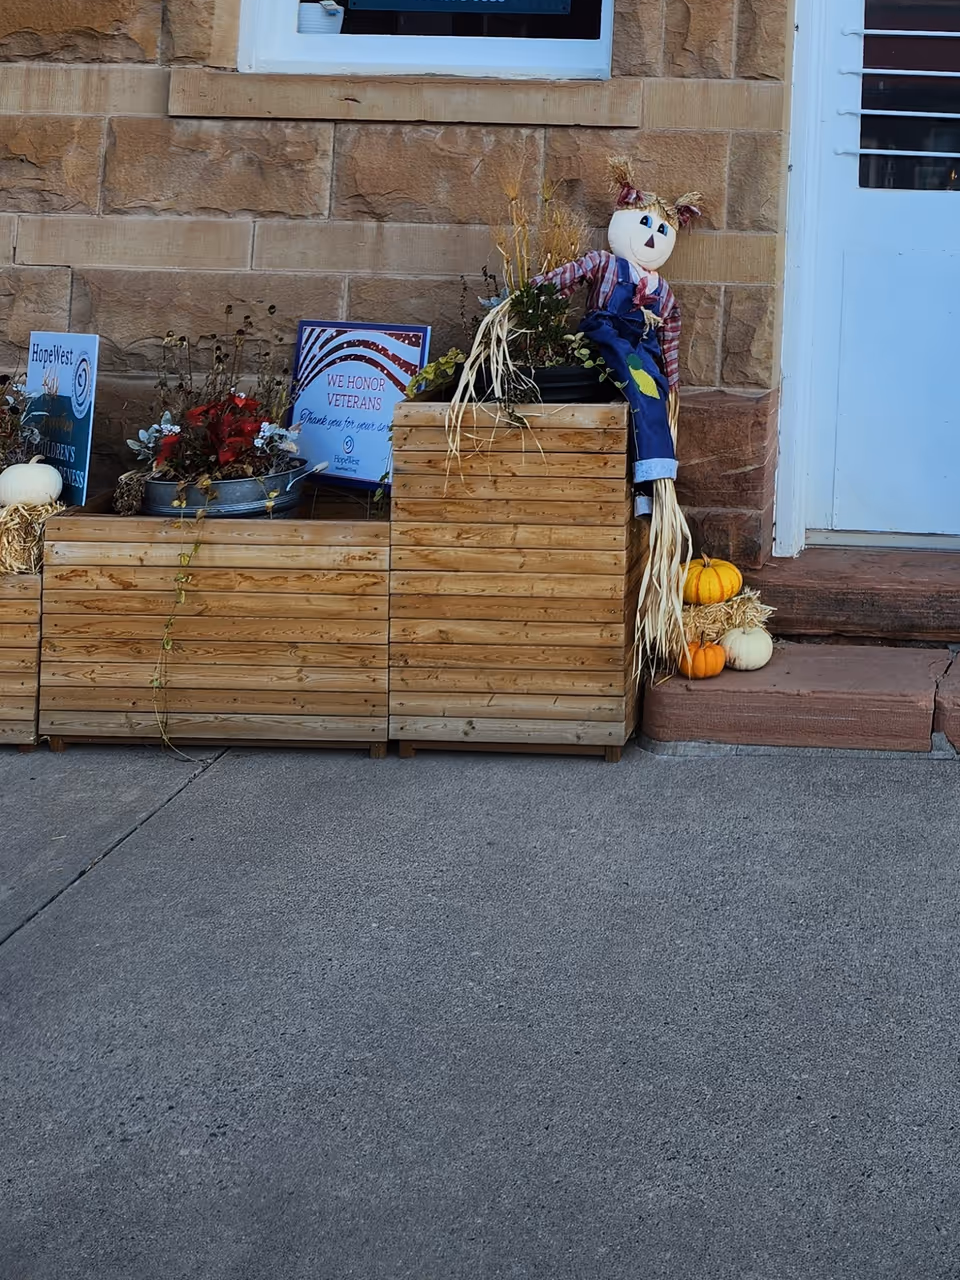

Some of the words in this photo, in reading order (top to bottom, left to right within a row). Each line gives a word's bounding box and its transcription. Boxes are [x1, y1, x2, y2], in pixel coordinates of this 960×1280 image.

[32, 343, 74, 370] HopeWest
[328, 374, 344, 388] WE
[346, 376, 386, 392] HONOR
[328, 393, 382, 411] VETERANS
[300, 408, 328, 426] Thank
[328, 420, 342, 430] you
[342, 416, 355, 432] for
[356, 422, 376, 434] your
